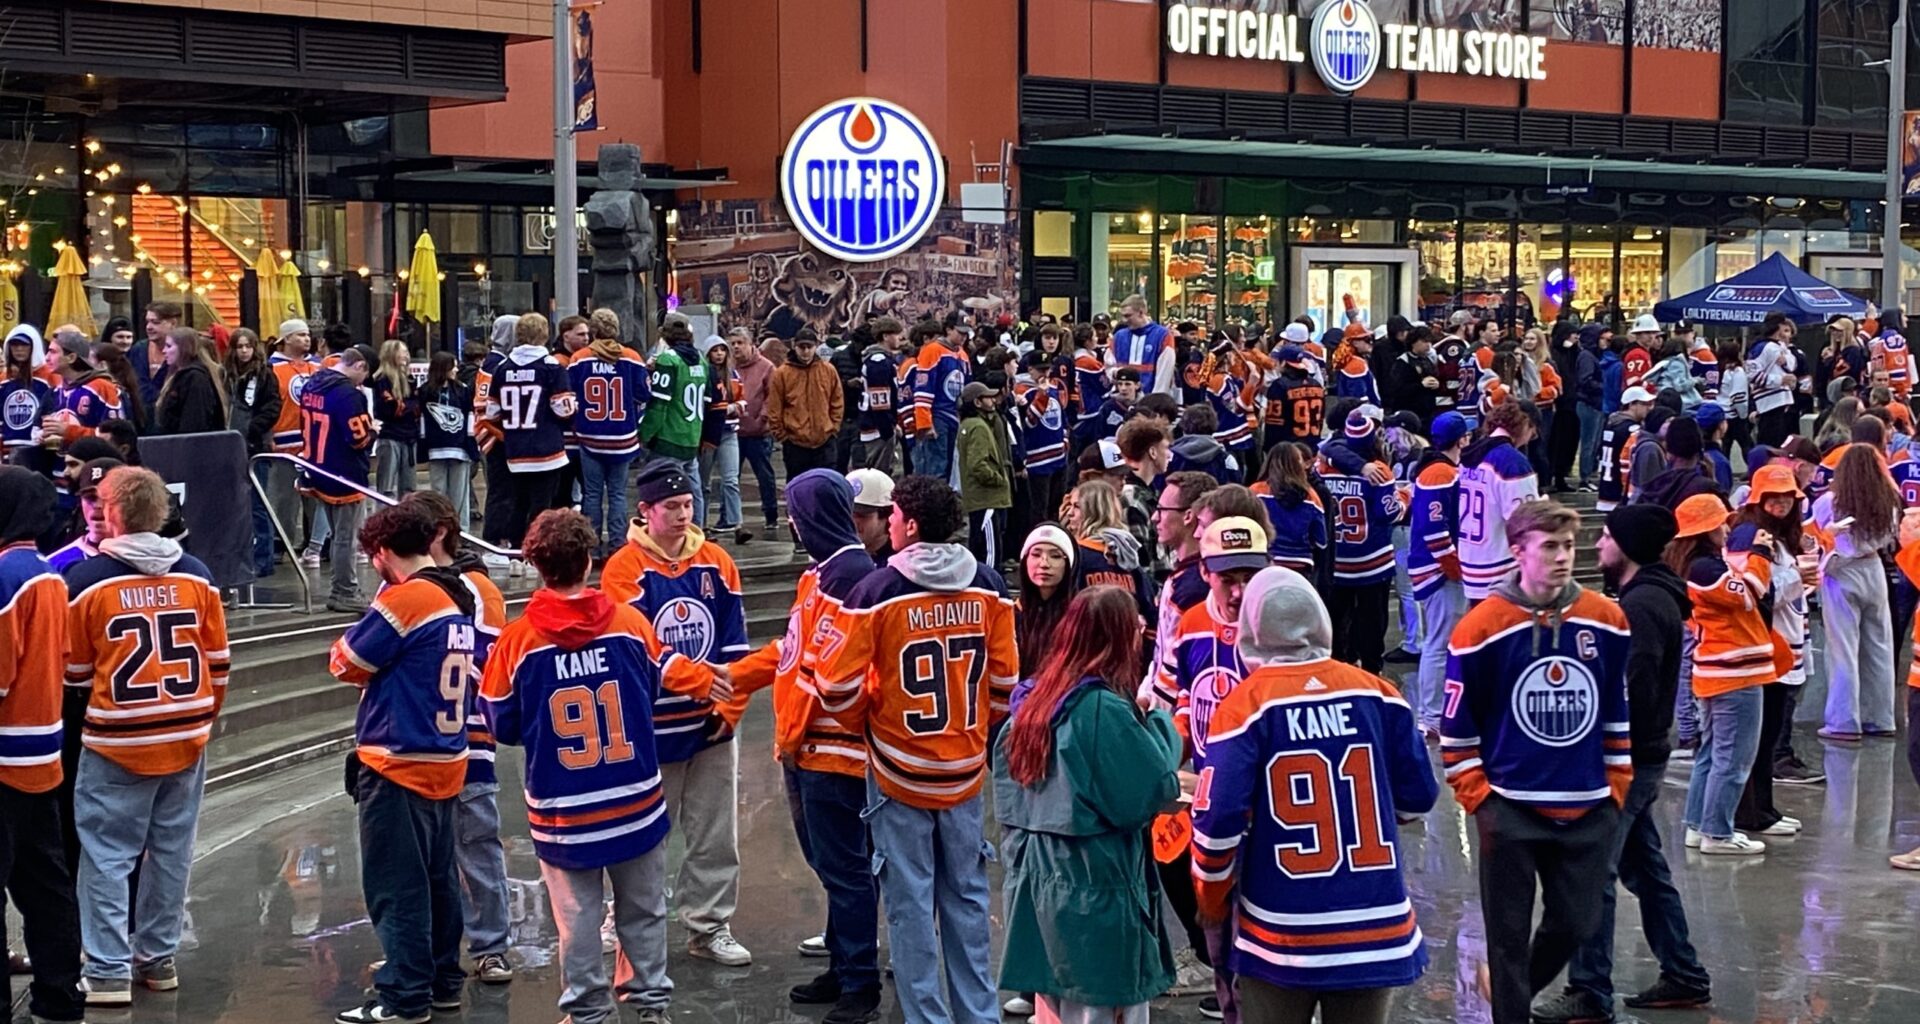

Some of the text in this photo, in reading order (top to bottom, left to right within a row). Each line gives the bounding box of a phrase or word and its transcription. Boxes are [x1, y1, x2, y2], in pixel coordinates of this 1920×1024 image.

[1168, 4, 1547, 80] OFFICIAL TEAM STORE
[1326, 30, 1370, 77] OILERS
[806, 159, 920, 238] OILERS
[1683, 307, 1768, 322] LOILTYREWARDS.CO
[592, 361, 618, 375] KANE
[652, 371, 671, 388] 90
[1627, 360, 1645, 372] 97
[500, 385, 542, 430] 97
[583, 376, 627, 422] 91
[871, 391, 888, 406] 93
[1293, 399, 1323, 437] 93
[1428, 501, 1444, 521] 2
[119, 584, 180, 609] NURSE
[701, 571, 716, 600] A
[907, 600, 983, 632] McDAVID
[105, 608, 201, 705] 25
[663, 621, 705, 656] OILERS
[1576, 629, 1599, 661] C
[554, 646, 610, 681] KANE
[899, 631, 988, 737] 97
[1444, 678, 1465, 719] 7
[549, 679, 635, 771] 91
[1286, 702, 1358, 742] KANE
[1527, 689, 1587, 732] OILERS
[1266, 743, 1397, 880] 91
